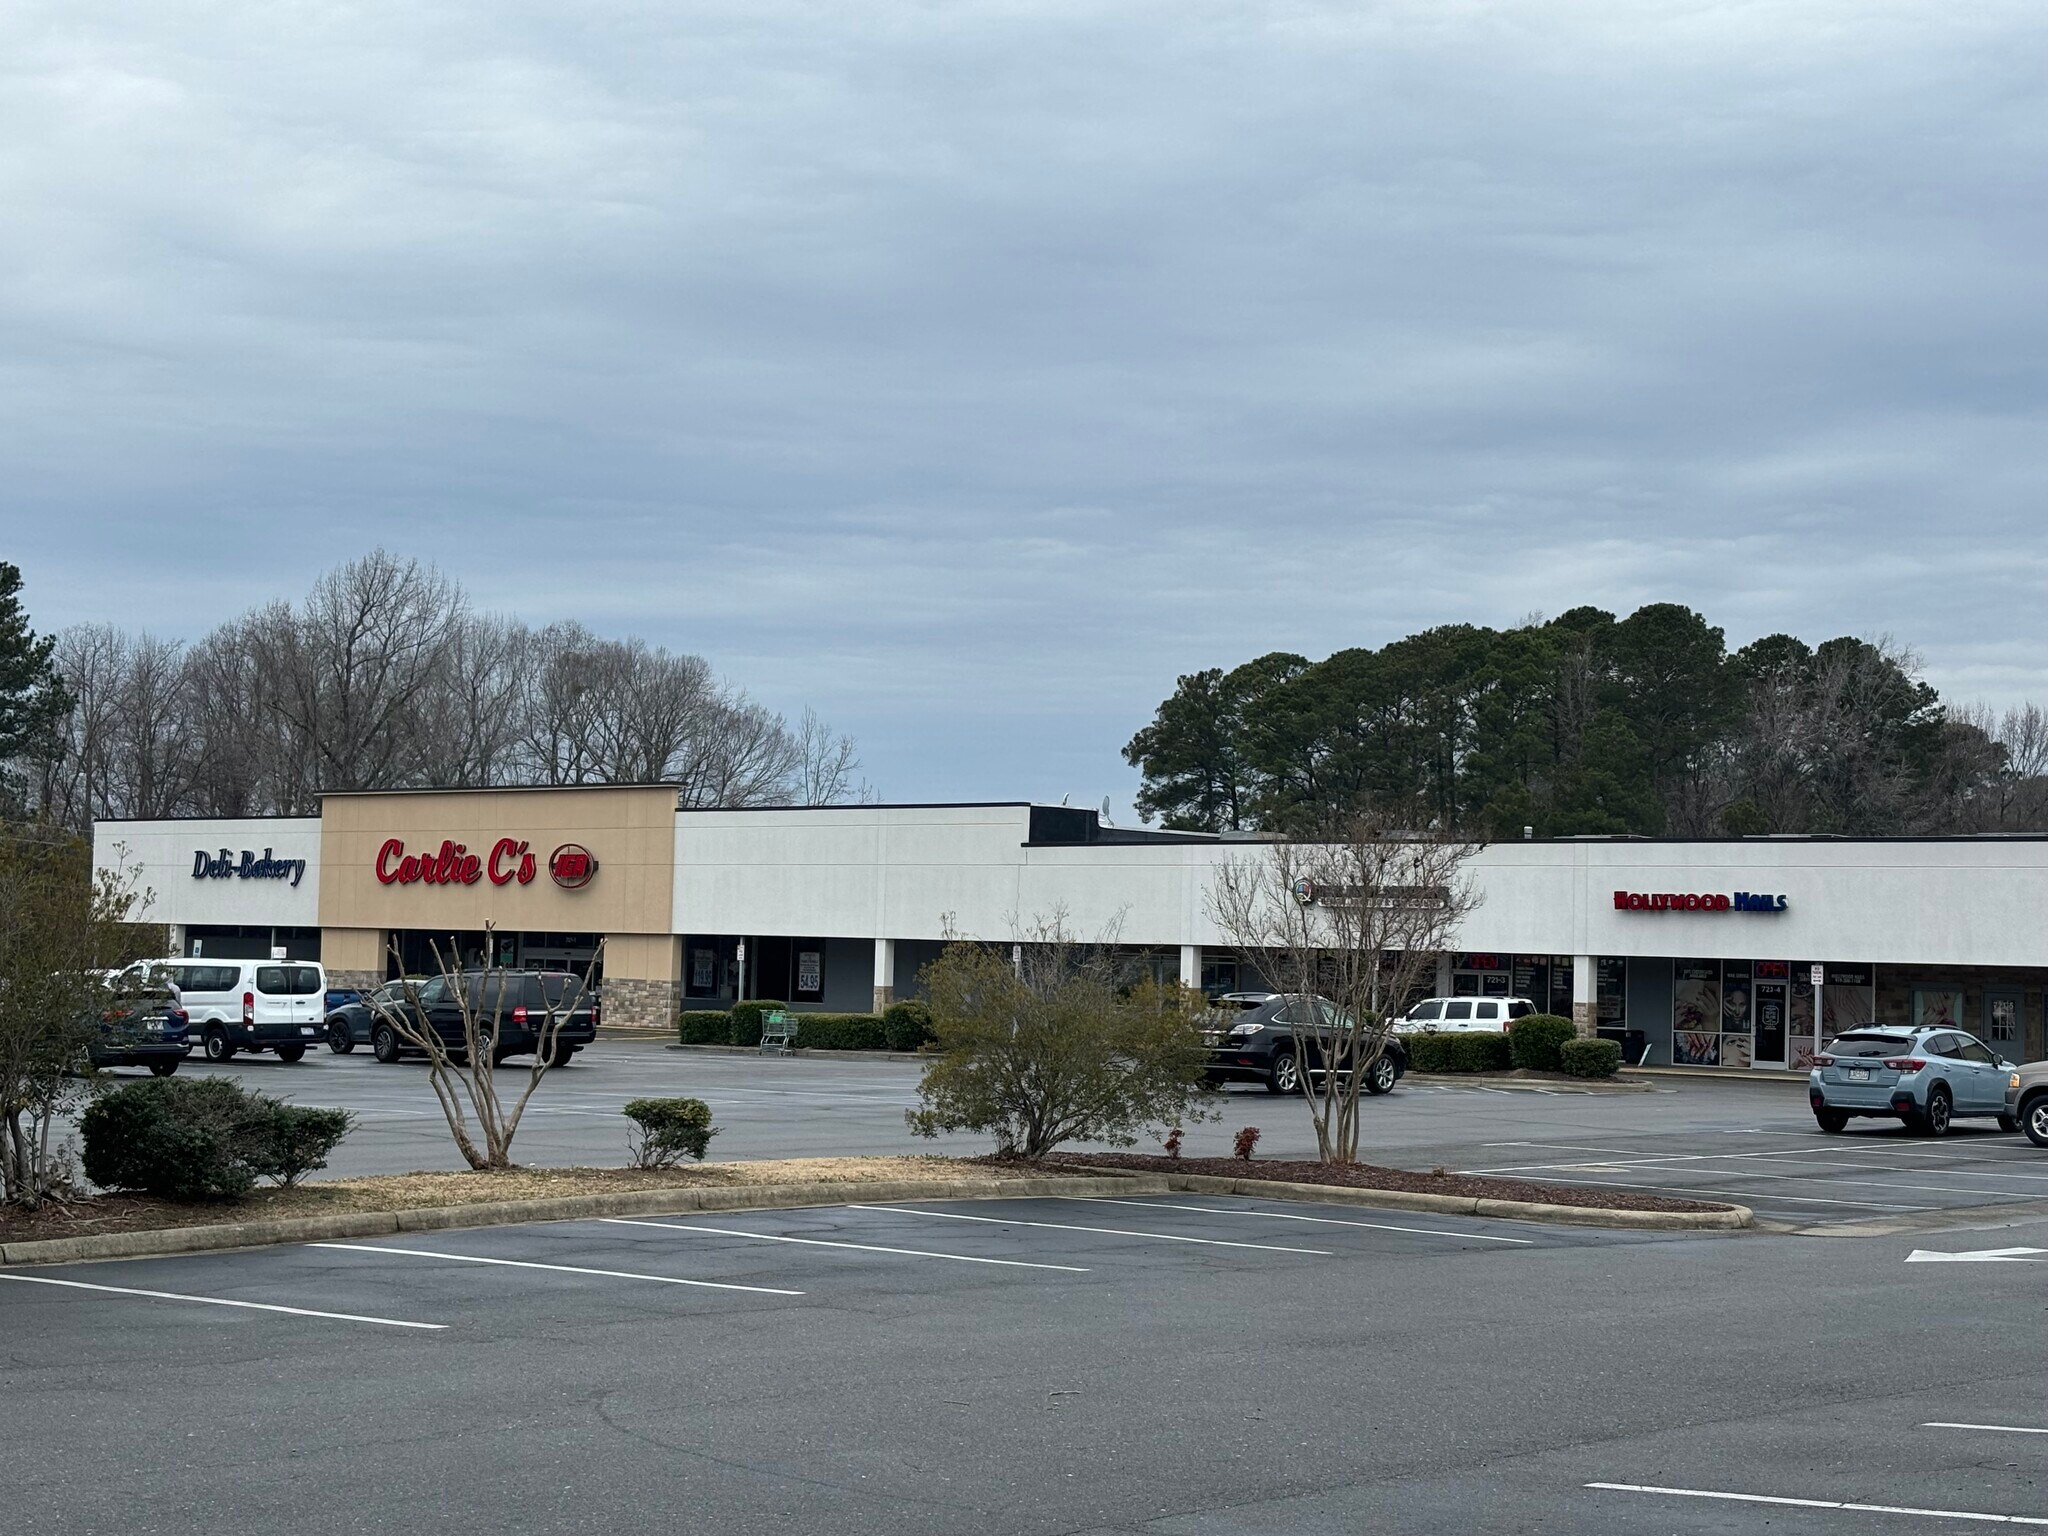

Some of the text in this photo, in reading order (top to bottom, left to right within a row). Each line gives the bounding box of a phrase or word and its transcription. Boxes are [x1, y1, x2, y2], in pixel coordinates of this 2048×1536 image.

[191, 848, 306, 887] Deli-Bakery
[376, 838, 537, 886] Carlie C's
[554, 853, 589, 879] IGA
[801, 974, 819, 989] 54.95
[1756, 962, 1788, 977] OPEN
